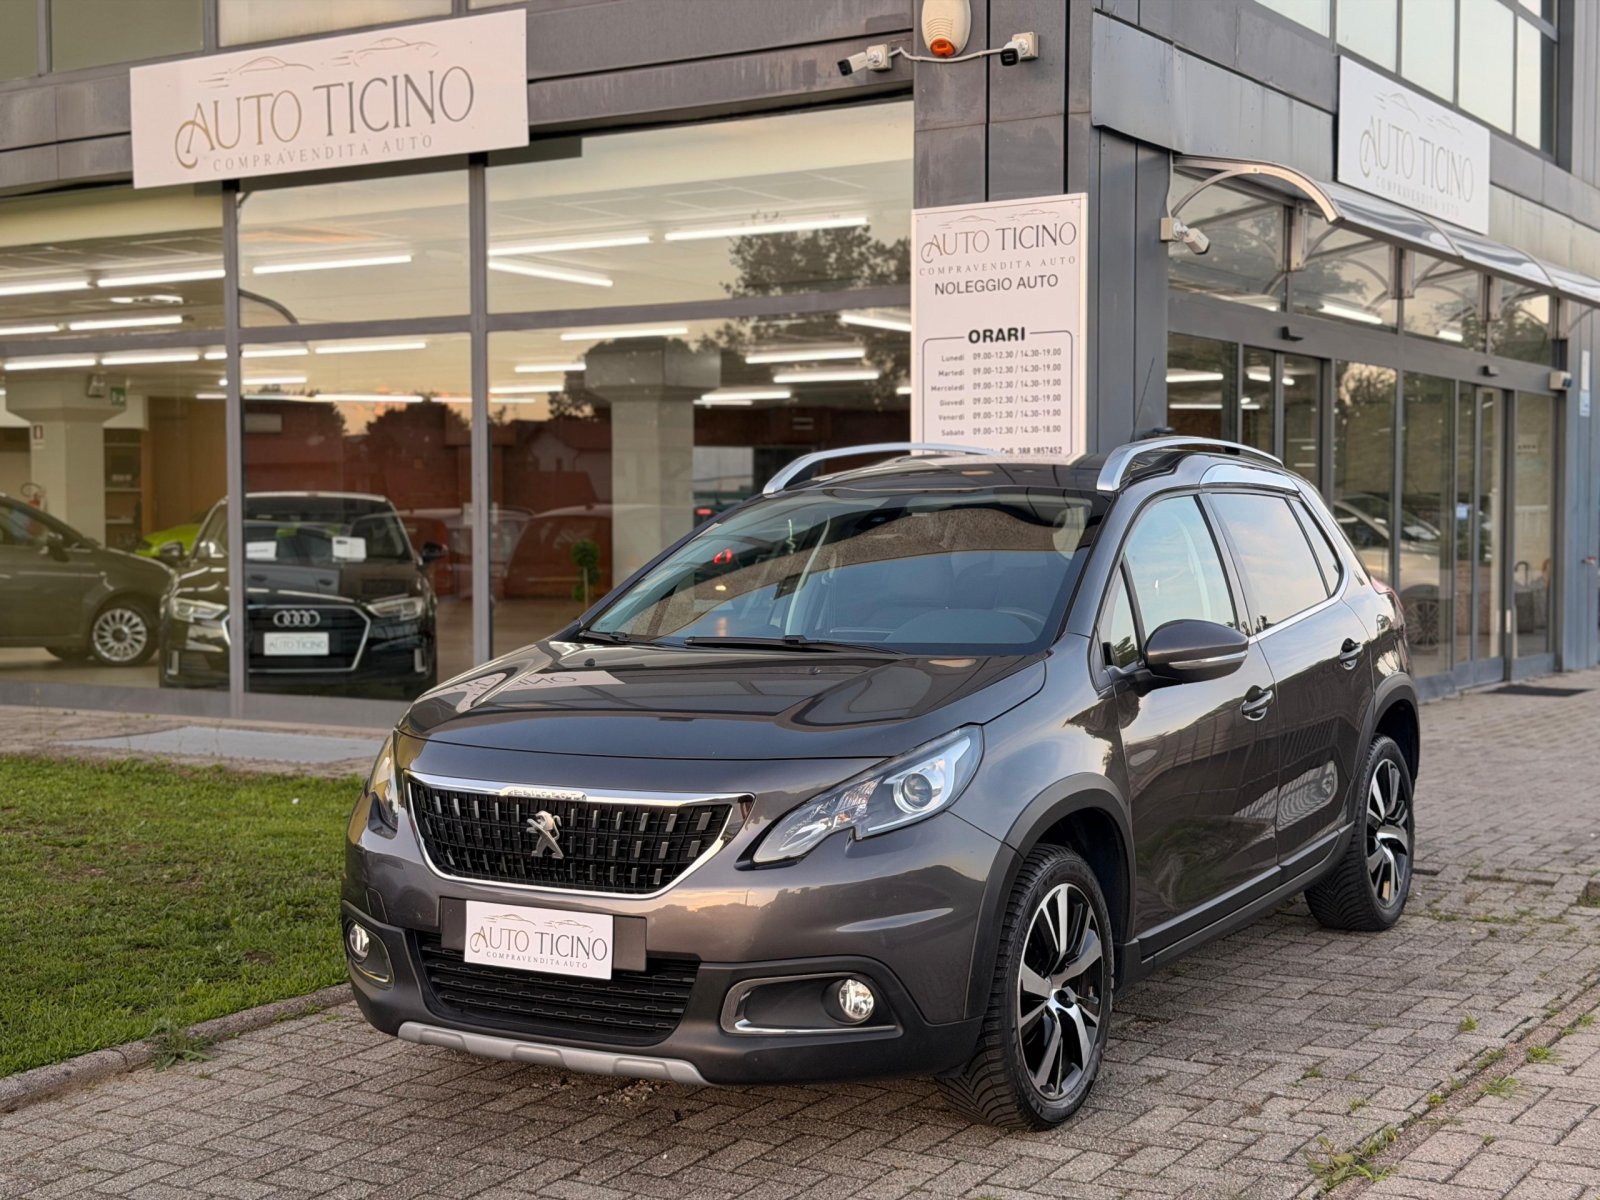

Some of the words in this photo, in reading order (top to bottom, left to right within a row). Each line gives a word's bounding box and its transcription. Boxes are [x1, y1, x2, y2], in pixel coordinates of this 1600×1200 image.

[175, 90, 302, 169] AUTO
[313, 66, 474, 136] TICINO
[213, 144, 369, 172] COMPRAVENDITA
[383, 135, 432, 153] AUTO
[1359, 114, 1415, 179] AUTO
[1419, 137, 1474, 203] TICINO
[920, 229, 990, 264] AUTO
[995, 221, 1077, 251] TICINO
[919, 260, 1031, 276] COMPRAVENDITA
[1040, 255, 1076, 267] AUTO
[934, 277, 1012, 296] NOLEGGIO
[1016, 273, 1058, 290] AUTO
[968, 326, 1026, 344] ORARI
[941, 429, 965, 437] Sabato
[469, 925, 529, 954] AUTO
[534, 931, 608, 961] TICINO
[486, 951, 560, 966] COMPRAVENDITA
[563, 960, 588, 969] AUTO
